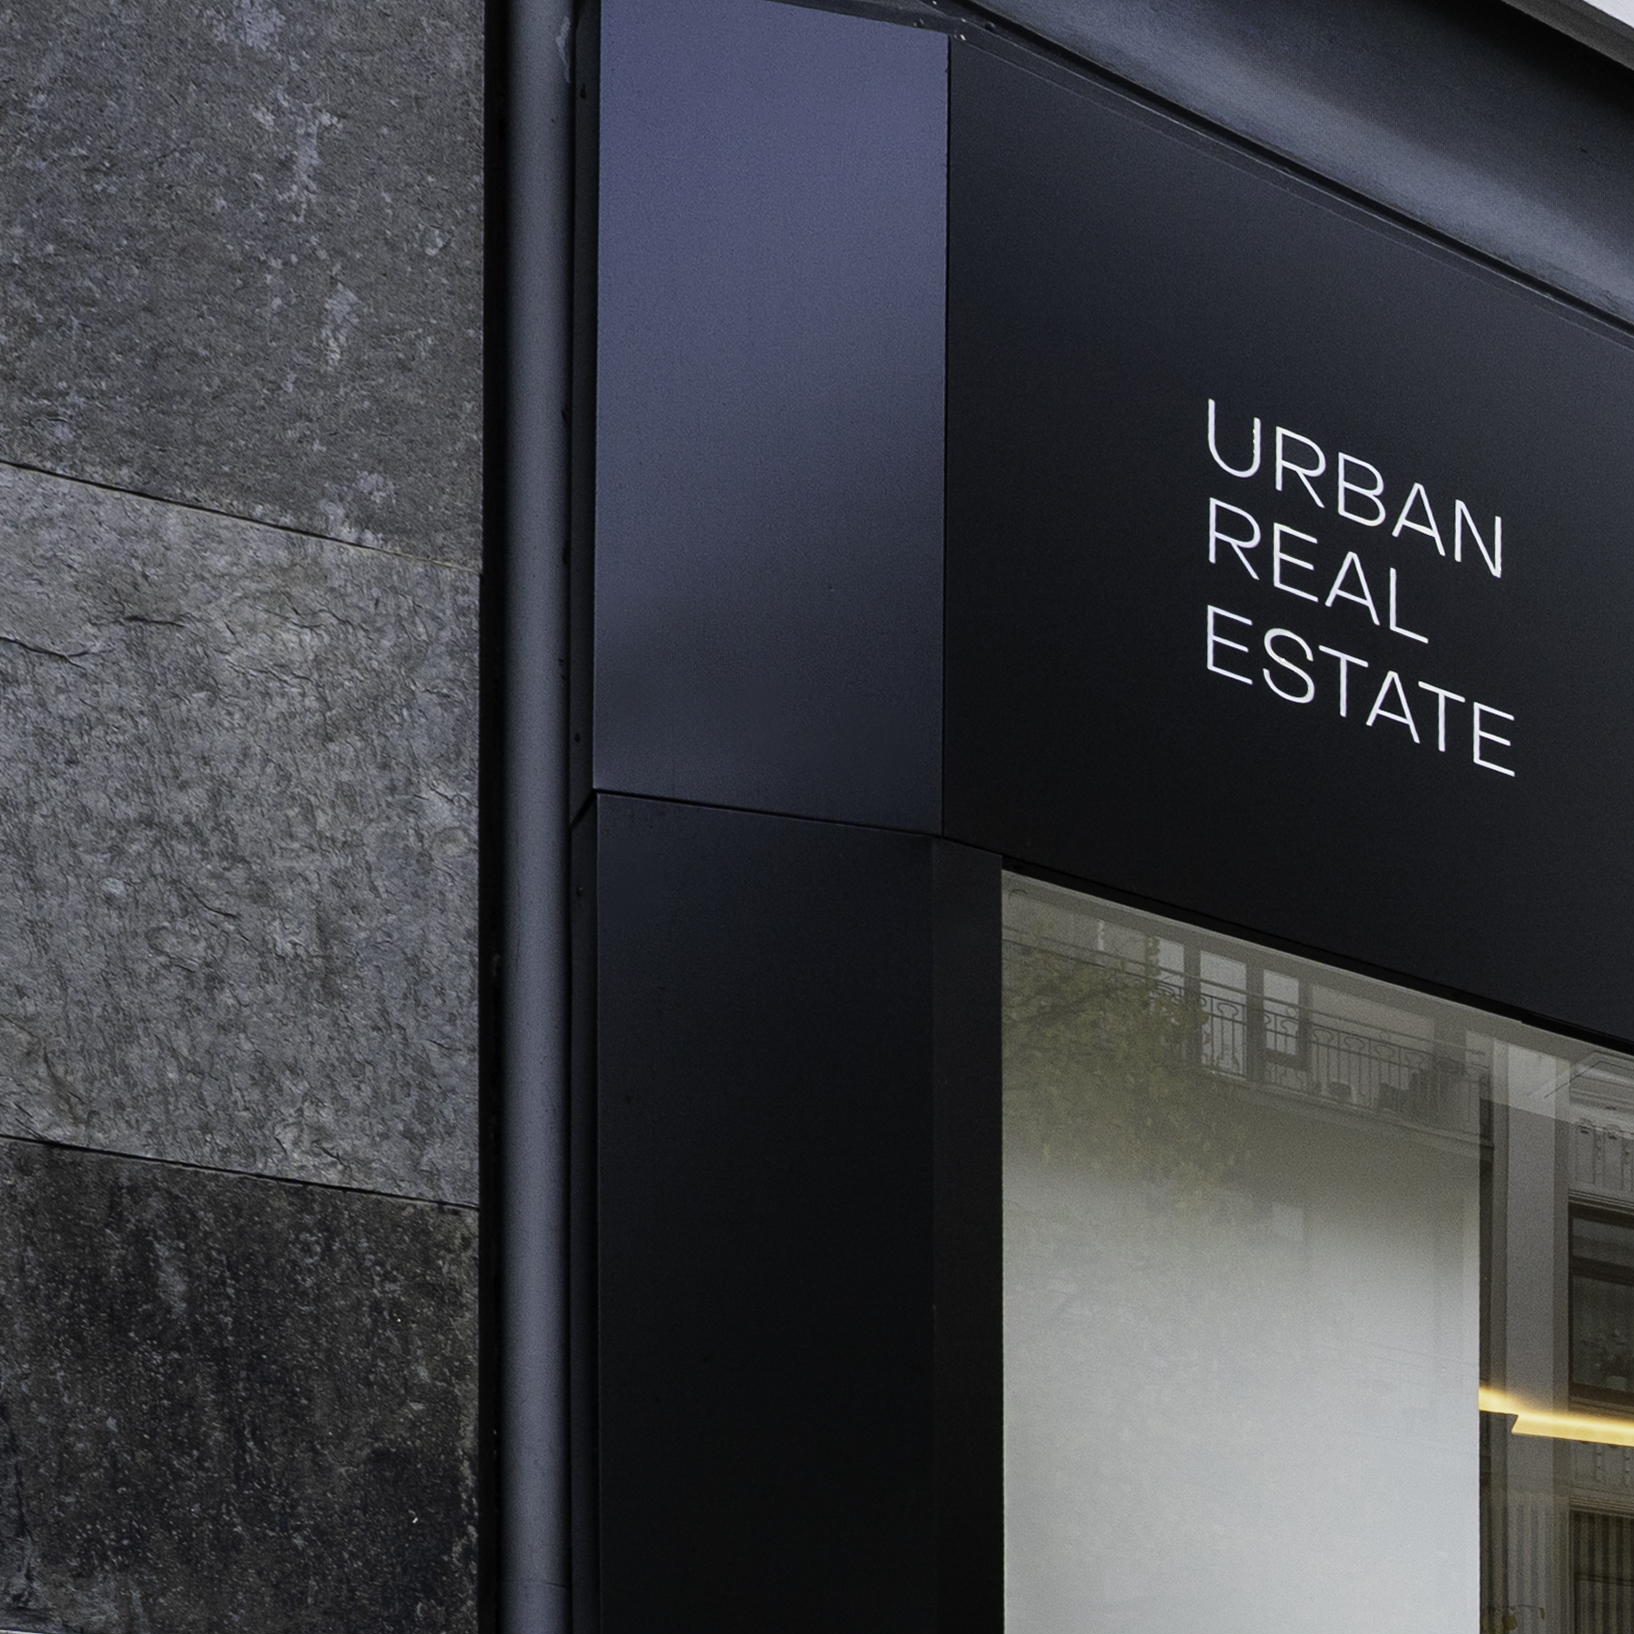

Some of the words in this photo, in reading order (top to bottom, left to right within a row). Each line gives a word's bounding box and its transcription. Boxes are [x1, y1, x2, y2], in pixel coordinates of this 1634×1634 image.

[1208, 399, 1502, 578] URBAN
[1209, 497, 1429, 644] REAL
[1207, 605, 1515, 777] ESTATE
